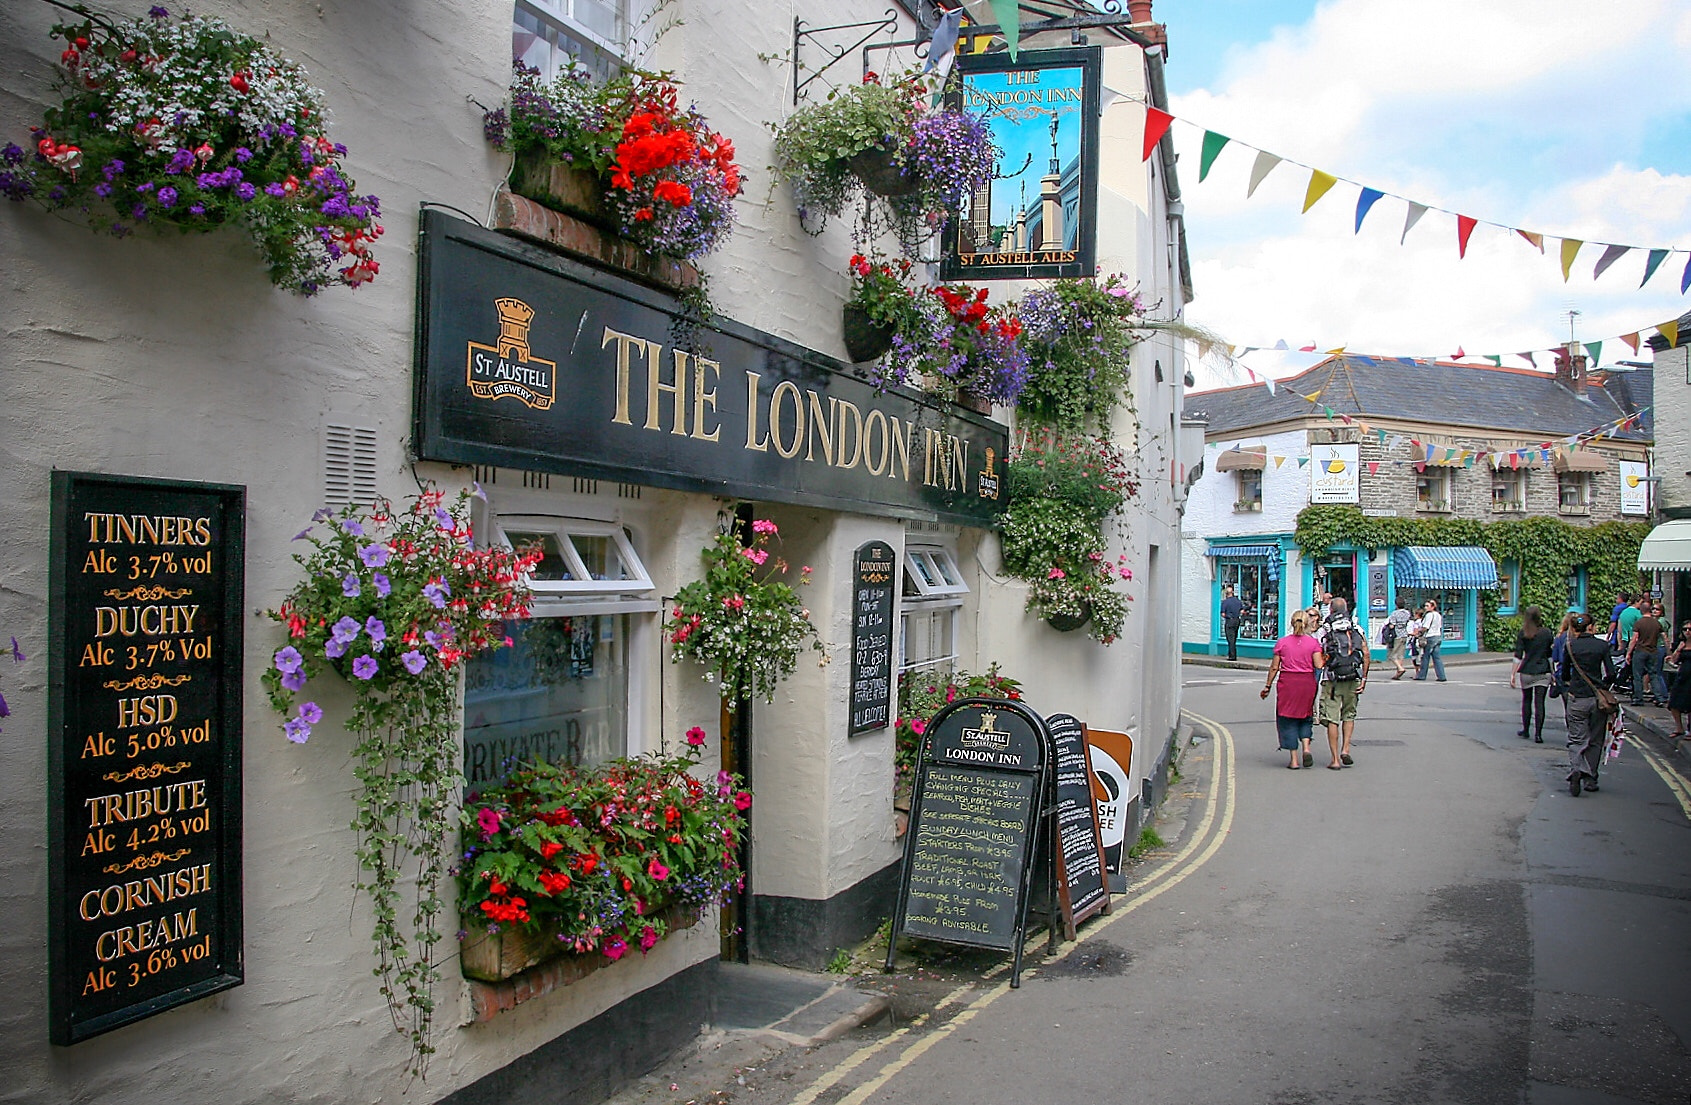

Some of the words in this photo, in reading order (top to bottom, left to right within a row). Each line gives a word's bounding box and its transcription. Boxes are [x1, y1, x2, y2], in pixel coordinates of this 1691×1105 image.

[1004, 70, 1040, 86] THE
[963, 90, 1041, 107] LONDON
[1047, 86, 1083, 103] INN
[981, 252, 1038, 265] AUSTELL
[1042, 250, 1076, 263] ALES
[475, 353, 493, 376] ST
[495, 359, 549, 388] AUSTELL
[494, 384, 532, 400] BREWERY
[601, 326, 721, 442] THE
[745, 370, 913, 482] LONDON
[923, 427, 970, 494] INN
[1315, 475, 1355, 487] custard
[84, 511, 212, 547] TINNERS
[82, 549, 117, 576] Alc
[128, 553, 178, 580] 3.7%
[181, 550, 212, 575] vol
[94, 604, 200, 639] DUCHY
[79, 641, 115, 668] Alc
[125, 642, 175, 671] 3.7%
[179, 635, 212, 661] Vol
[117, 694, 178, 731] HSD
[81, 732, 116, 759] Alc
[126, 727, 176, 755] 5.0%
[181, 720, 210, 747] vol
[976, 732, 1006, 743] AUSTELL
[464, 729, 560, 783] RIVATE
[945, 748, 995, 763] LONDON
[999, 753, 1022, 765] INN
[925, 781, 969, 793] CHANGING
[929, 770, 948, 781] FULL
[950, 774, 973, 783] MENU
[976, 776, 996, 787] PLUS
[998, 780, 1021, 790] DAILY
[85, 779, 207, 829] TRIBUTE
[80, 827, 116, 857] Alc
[126, 819, 176, 853] 4.2%
[180, 809, 210, 838] vol
[920, 824, 959, 835] SUNDAY
[960, 827, 989, 838] LUNCH
[991, 832, 1014, 843] MENU
[918, 838, 963, 850] STARTERS
[964, 842, 985, 853] FROM
[915, 850, 968, 866] TRADITIONAL
[972, 857, 1000, 870] ROAST
[79, 863, 211, 923] CORNISH
[965, 881, 986, 891] CHILD
[909, 887, 950, 903] HOMEMADE
[975, 898, 999, 911] FROM
[906, 912, 938, 925] BOOKING
[96, 907, 198, 965] CREAM
[81, 968, 116, 997] Alc
[128, 952, 177, 989] 3.6%
[181, 940, 210, 967] vol
